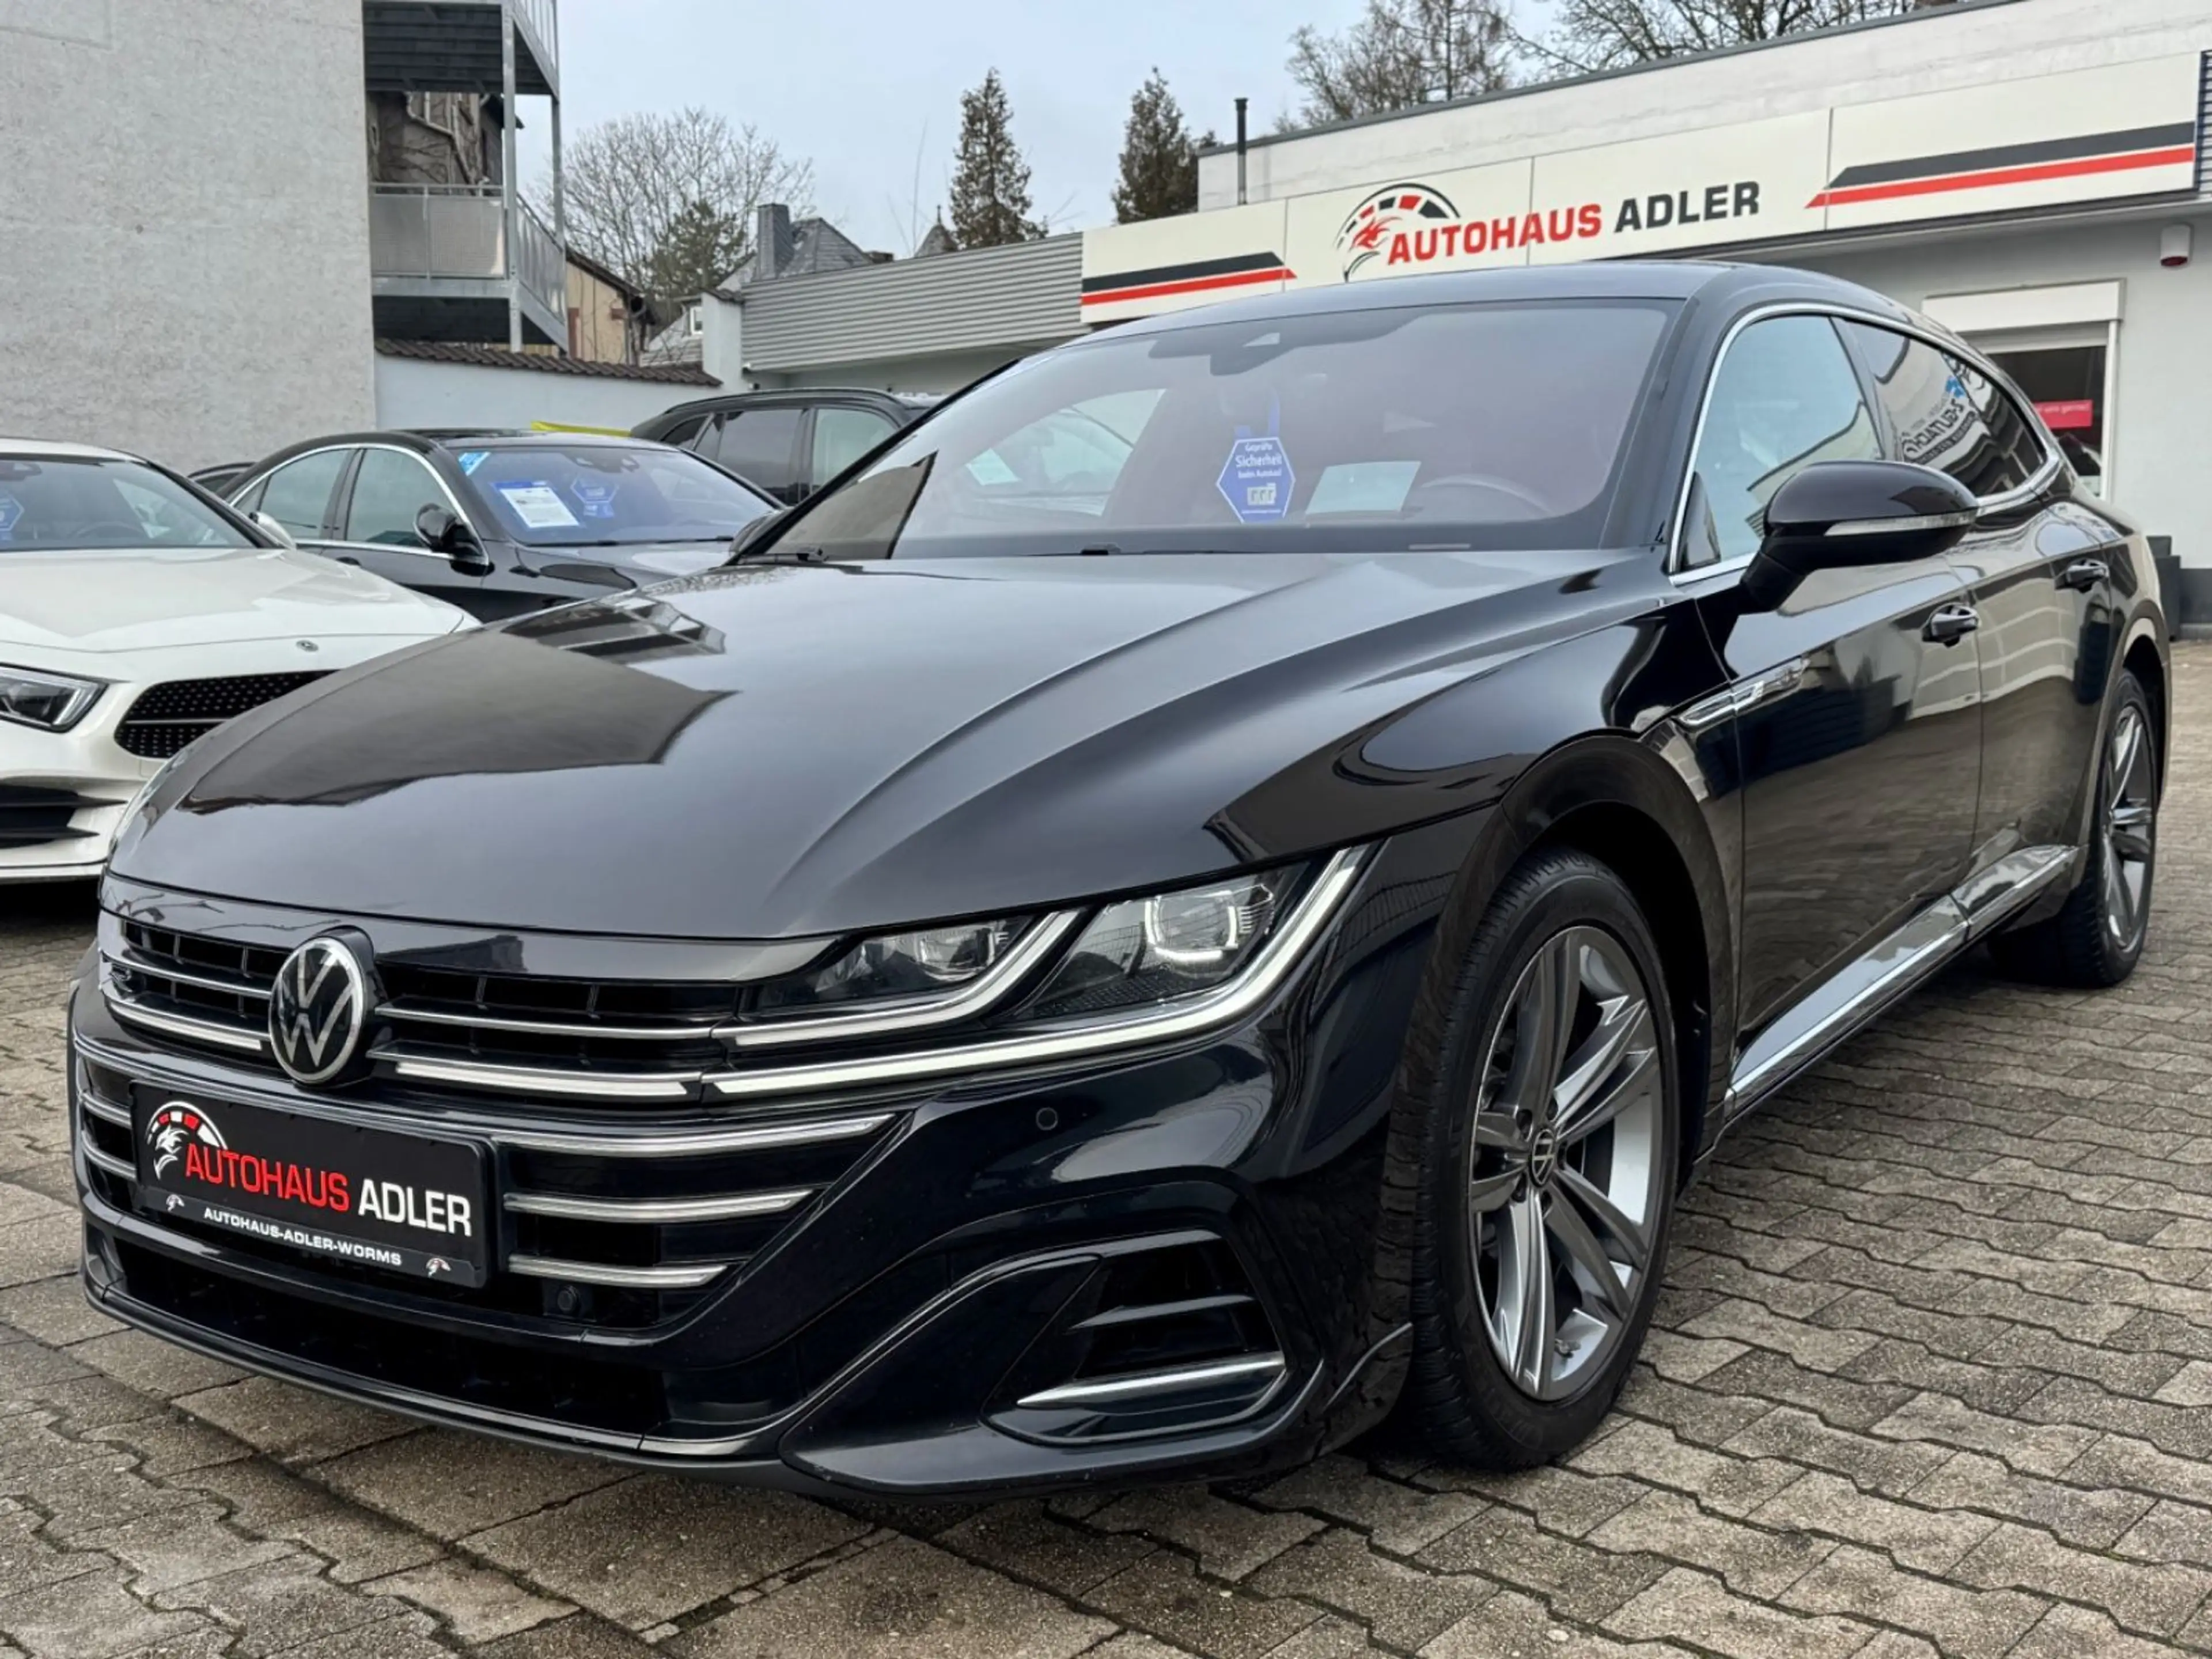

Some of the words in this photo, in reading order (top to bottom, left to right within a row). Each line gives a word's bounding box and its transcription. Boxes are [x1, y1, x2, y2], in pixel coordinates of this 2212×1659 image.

[1387, 203, 1602, 266] AUTOHAUS
[1613, 180, 1760, 233] ADLER
[1235, 452, 1282, 468] Sicherheit
[185, 1143, 350, 1213] AUTOHAUS
[358, 1178, 472, 1237] ADLER
[203, 1207, 402, 1266] AUTOHAUS-ADLER-WORMS
